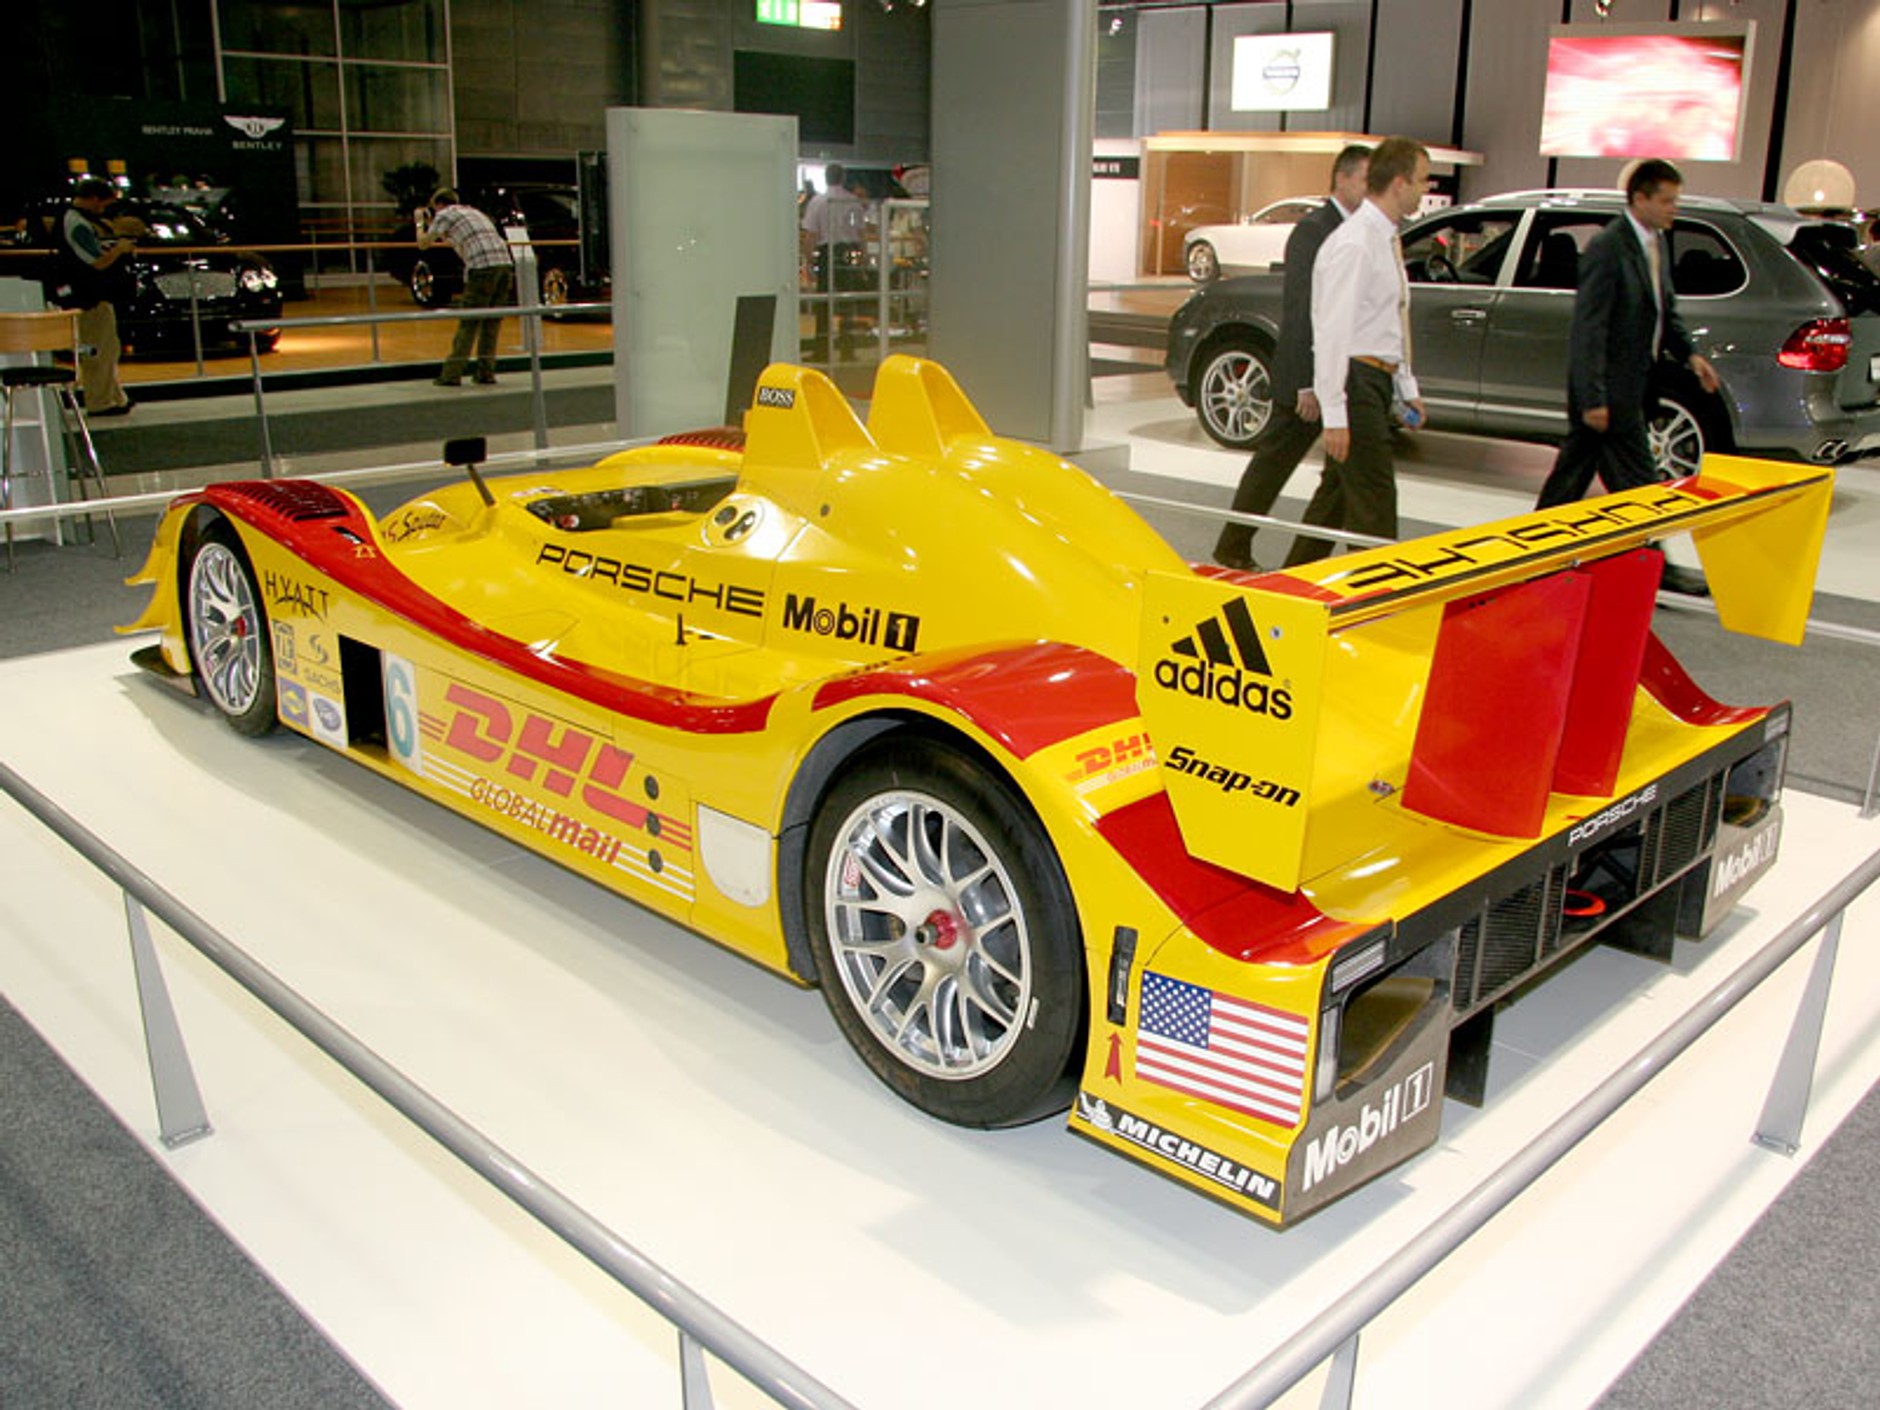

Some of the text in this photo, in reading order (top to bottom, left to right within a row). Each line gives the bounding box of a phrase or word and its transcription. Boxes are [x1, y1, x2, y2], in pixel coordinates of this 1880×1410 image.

[232, 140, 283, 150] BENTLEY
[760, 387, 793, 407] BOSS
[265, 569, 329, 623] HYATT
[536, 543, 765, 617] PORSCHE
[782, 594, 880, 645] Mobil
[387, 662, 415, 758] 6
[1155, 659, 1293, 720] adidas
[445, 683, 650, 830] DHL
[1164, 746, 1301, 807] Snap-on
[1567, 784, 1658, 847] PORSCHE
[1713, 834, 1761, 898] Mobil
[1118, 1114, 1276, 1200] MICHELIN
[1303, 1084, 1401, 1192] Mobil
